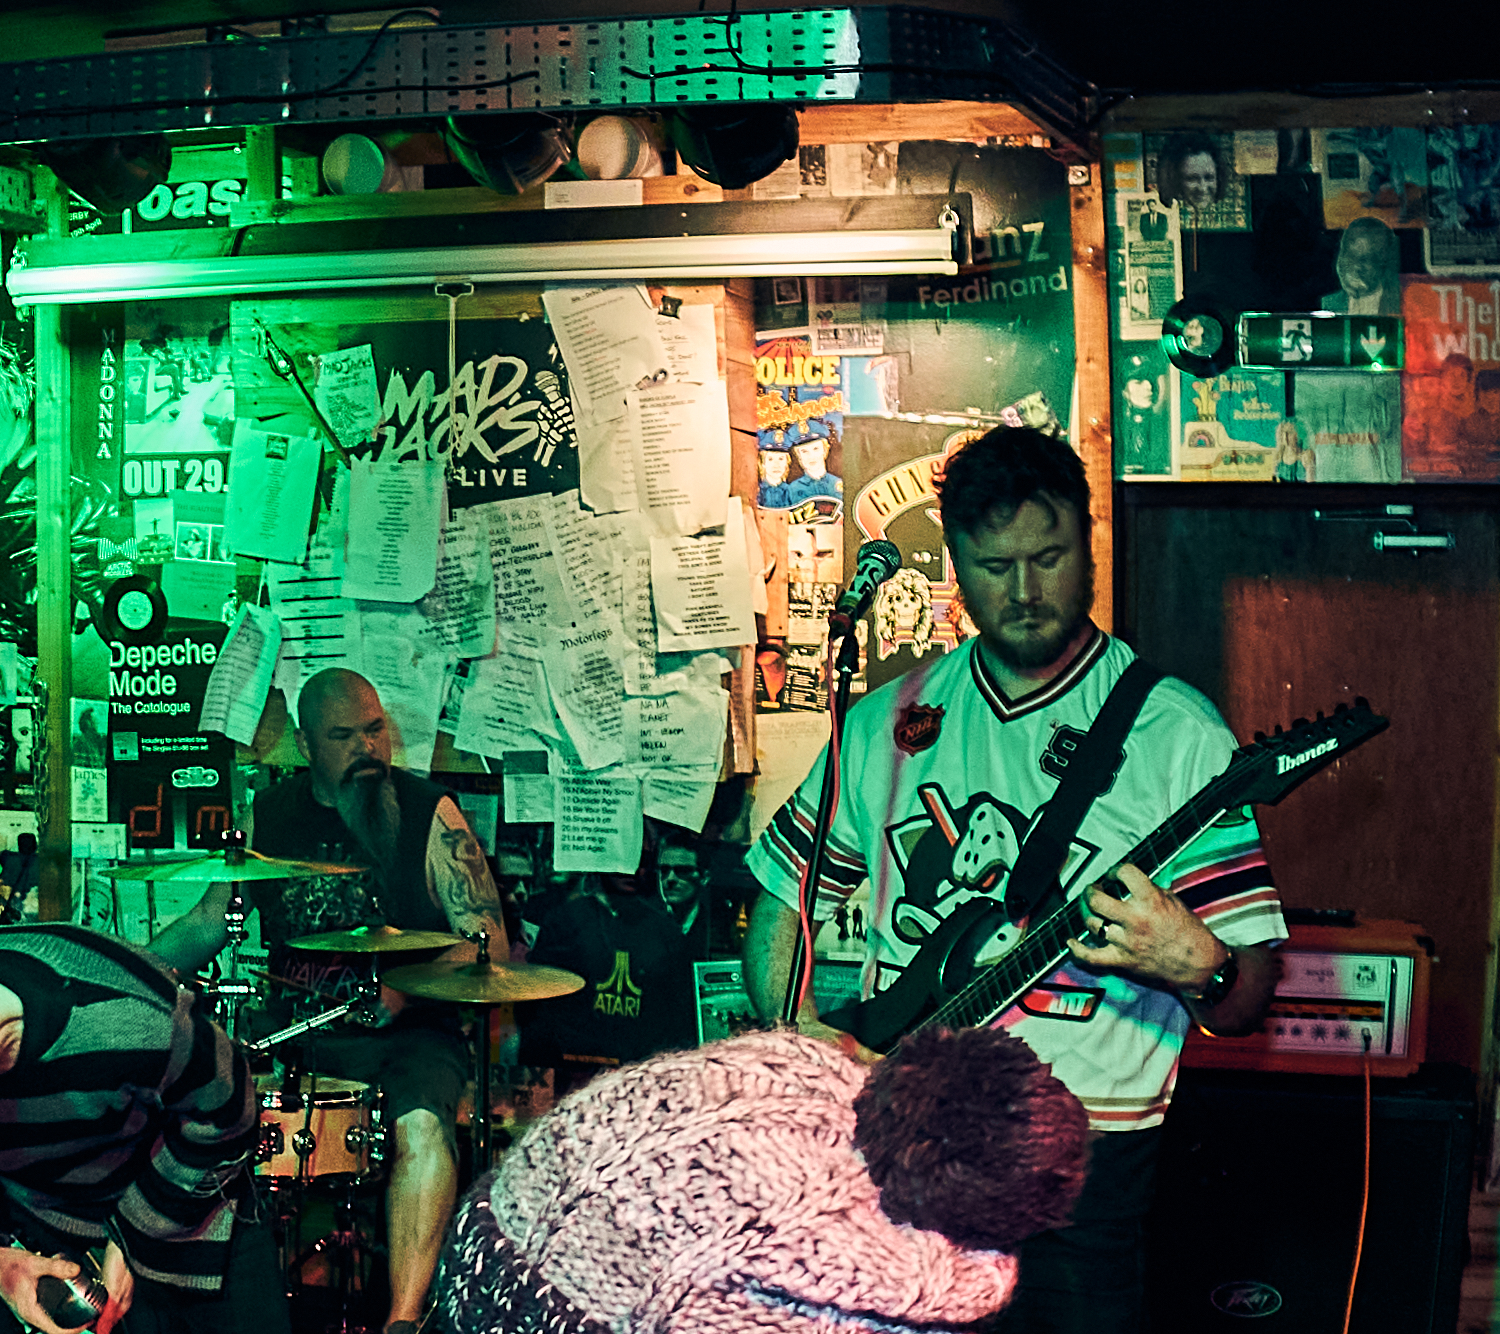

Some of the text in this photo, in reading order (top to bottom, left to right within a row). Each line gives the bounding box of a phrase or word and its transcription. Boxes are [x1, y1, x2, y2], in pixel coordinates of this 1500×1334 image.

[972, 219, 1050, 264] anz
[917, 266, 1068, 309] Ferdinand
[1431, 284, 1495, 327] The
[96, 328, 117, 459] MADONNA
[383, 354, 529, 427] MAD
[122, 459, 180, 496] OUT
[460, 468, 528, 487] LIVE
[110, 637, 217, 672] Depeche
[110, 669, 177, 697] Mode
[111, 700, 192, 716] The Catalogue
[1276, 737, 1339, 776] Ibanez
[593, 993, 642, 1017] ATARI
